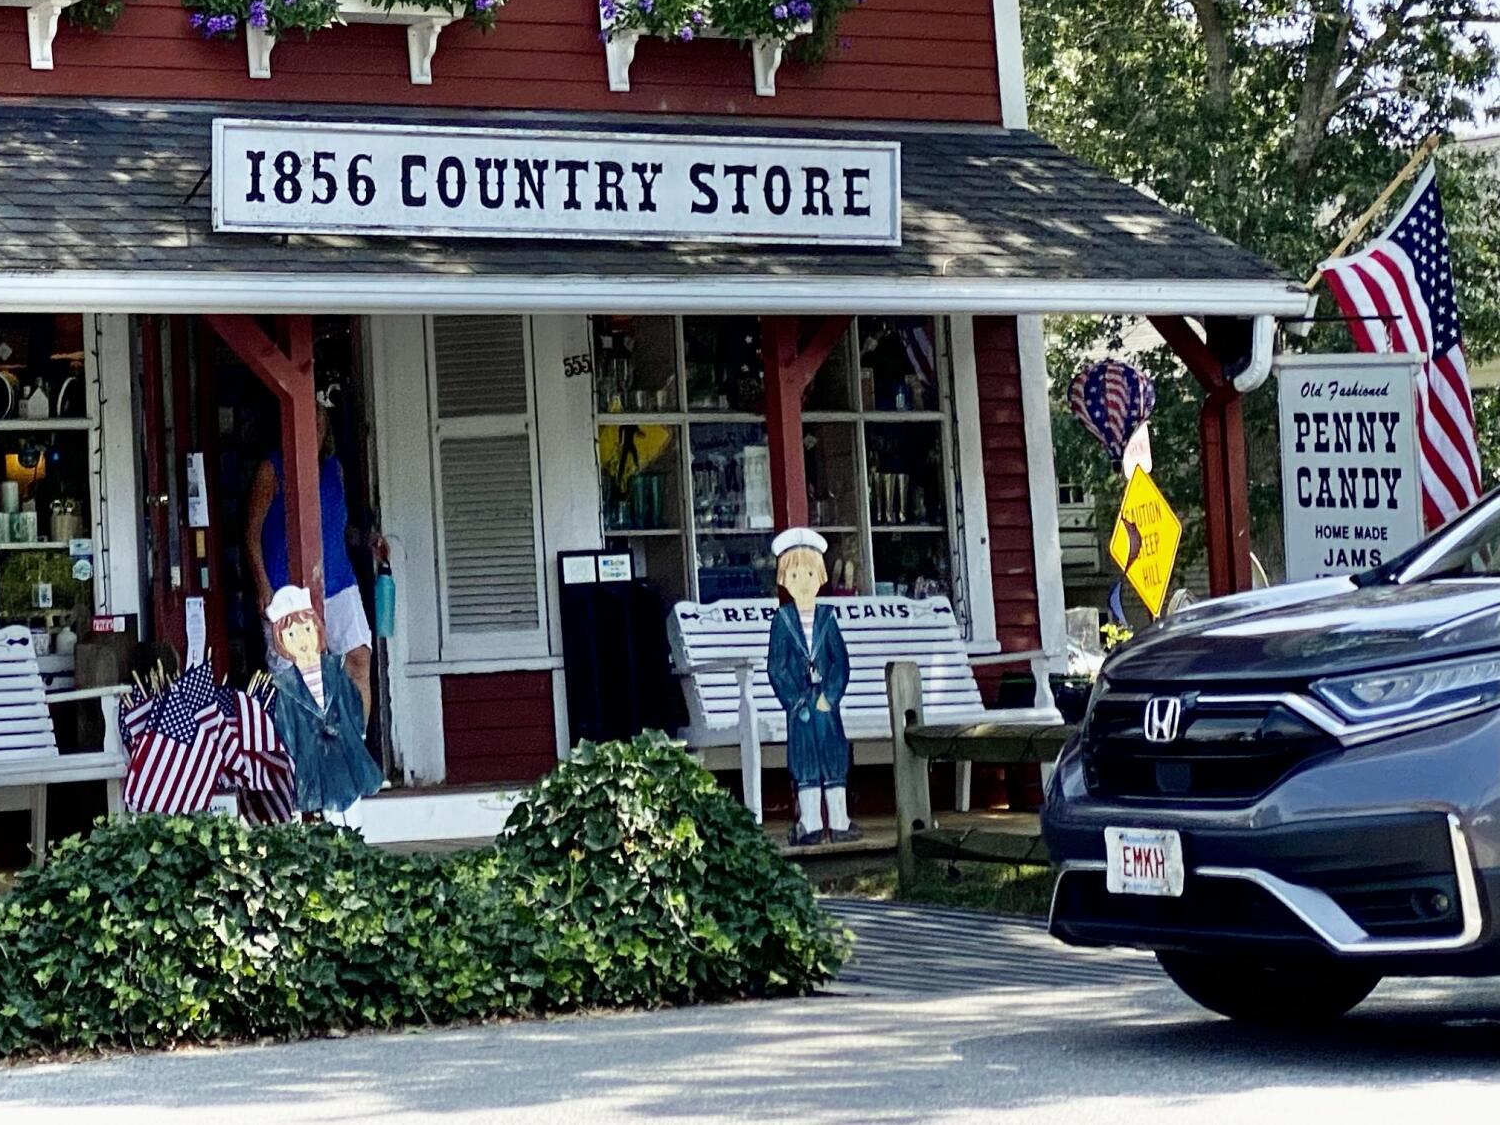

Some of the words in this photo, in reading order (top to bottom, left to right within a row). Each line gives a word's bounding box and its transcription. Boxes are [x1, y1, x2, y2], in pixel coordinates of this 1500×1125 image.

[246, 150, 377, 207] 1856
[401, 155, 664, 213] COUNTRY
[689, 162, 871, 217] STORE
[563, 354, 592, 378] 555
[1300, 381, 1324, 398] Old
[1327, 380, 1390, 402] Fashioned
[1293, 411, 1400, 453] PENNY
[1296, 467, 1402, 510] CANDY
[1138, 532, 1160, 559] TEEP
[1315, 525, 1350, 540] HOME
[1354, 525, 1388, 541] MADE
[1324, 548, 1383, 568] JAMS
[1142, 563, 1162, 588] HILL
[723, 604, 910, 623] REPICANS
[1123, 846, 1166, 879] EMKH
